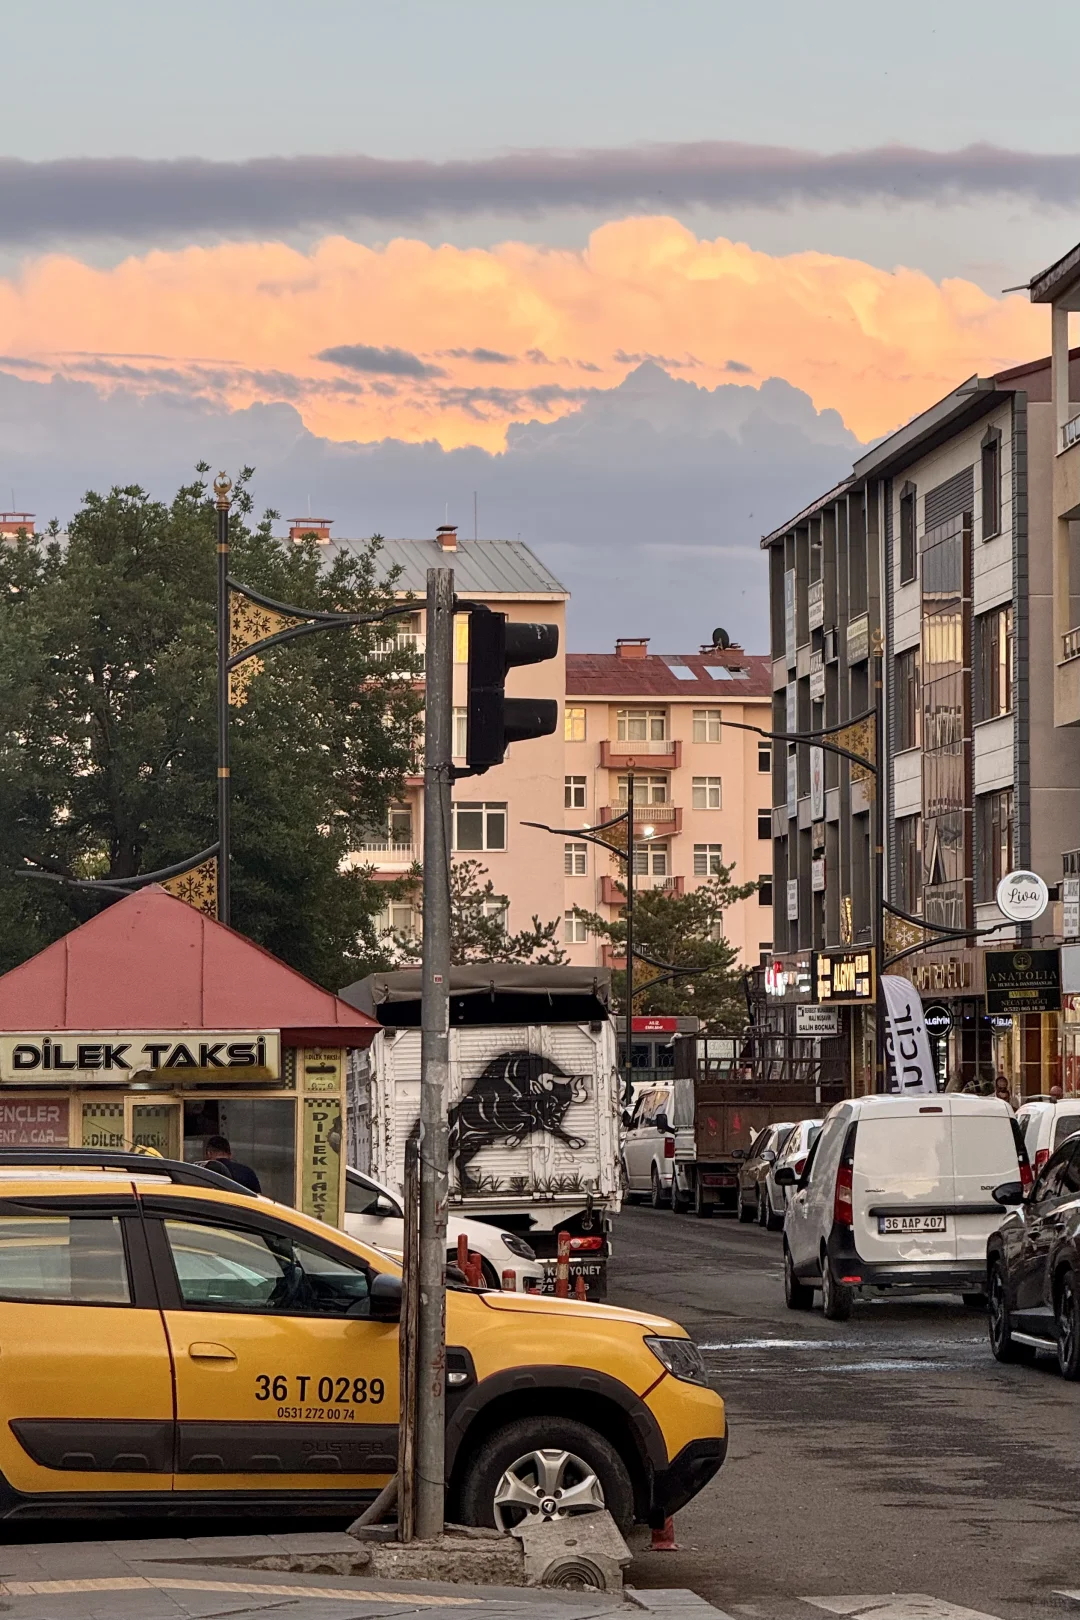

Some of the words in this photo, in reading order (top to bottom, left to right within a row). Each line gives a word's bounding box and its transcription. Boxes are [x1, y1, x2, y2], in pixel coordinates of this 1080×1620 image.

[1007, 888, 1040, 904] Liva
[924, 1016, 950, 1025] ALGİYİN
[13, 1036, 133, 1070] DİLEK
[141, 1035, 266, 1068] TAKSİ
[31, 1129, 54, 1143] CAR
[91, 1131, 124, 1148] DİLEK
[133, 1131, 162, 1147] AKSİ
[312, 1112, 329, 1166] DİLEK
[885, 1218, 899, 1229] 36
[902, 1218, 921, 1228] AAP
[924, 1217, 943, 1228] 407
[547, 1265, 602, 1276] KYONET
[255, 1374, 288, 1401] 36
[296, 1376, 311, 1402] T
[318, 1376, 385, 1404] 0289
[277, 1407, 303, 1418] 0531
[305, 1408, 324, 1419] 272
[327, 1409, 340, 1420] 00
[343, 1409, 355, 1420] 74
[302, 1442, 384, 1454] DUSTER
